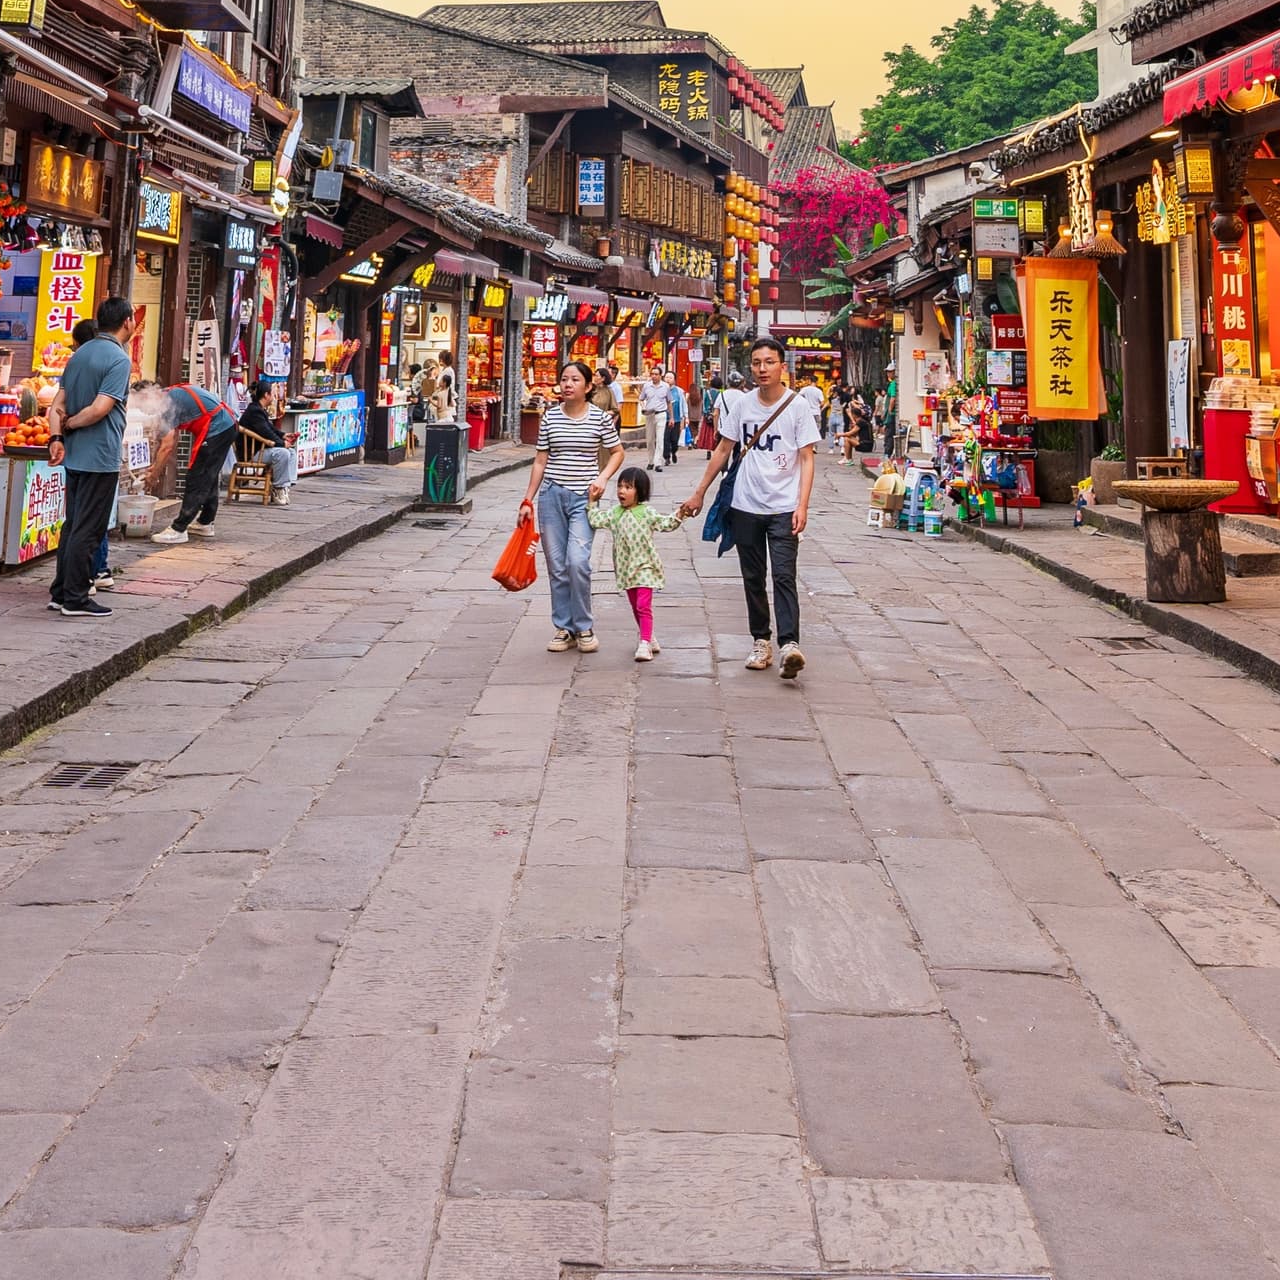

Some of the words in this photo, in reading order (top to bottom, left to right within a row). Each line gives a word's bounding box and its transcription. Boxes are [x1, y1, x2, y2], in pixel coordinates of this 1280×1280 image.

[658, 63, 682, 122] 龙隐码
[686, 70, 710, 121] 老火锅
[579, 160, 592, 204] 龙隐码头
[592, 160, 605, 204] 正在营业
[46, 252, 83, 332] 血橙汁
[1219, 247, 1247, 342] 合川桃
[432, 315, 448, 333] 30
[532, 328, 556, 341] 全场
[1049, 290, 1073, 396] 乐天茶社
